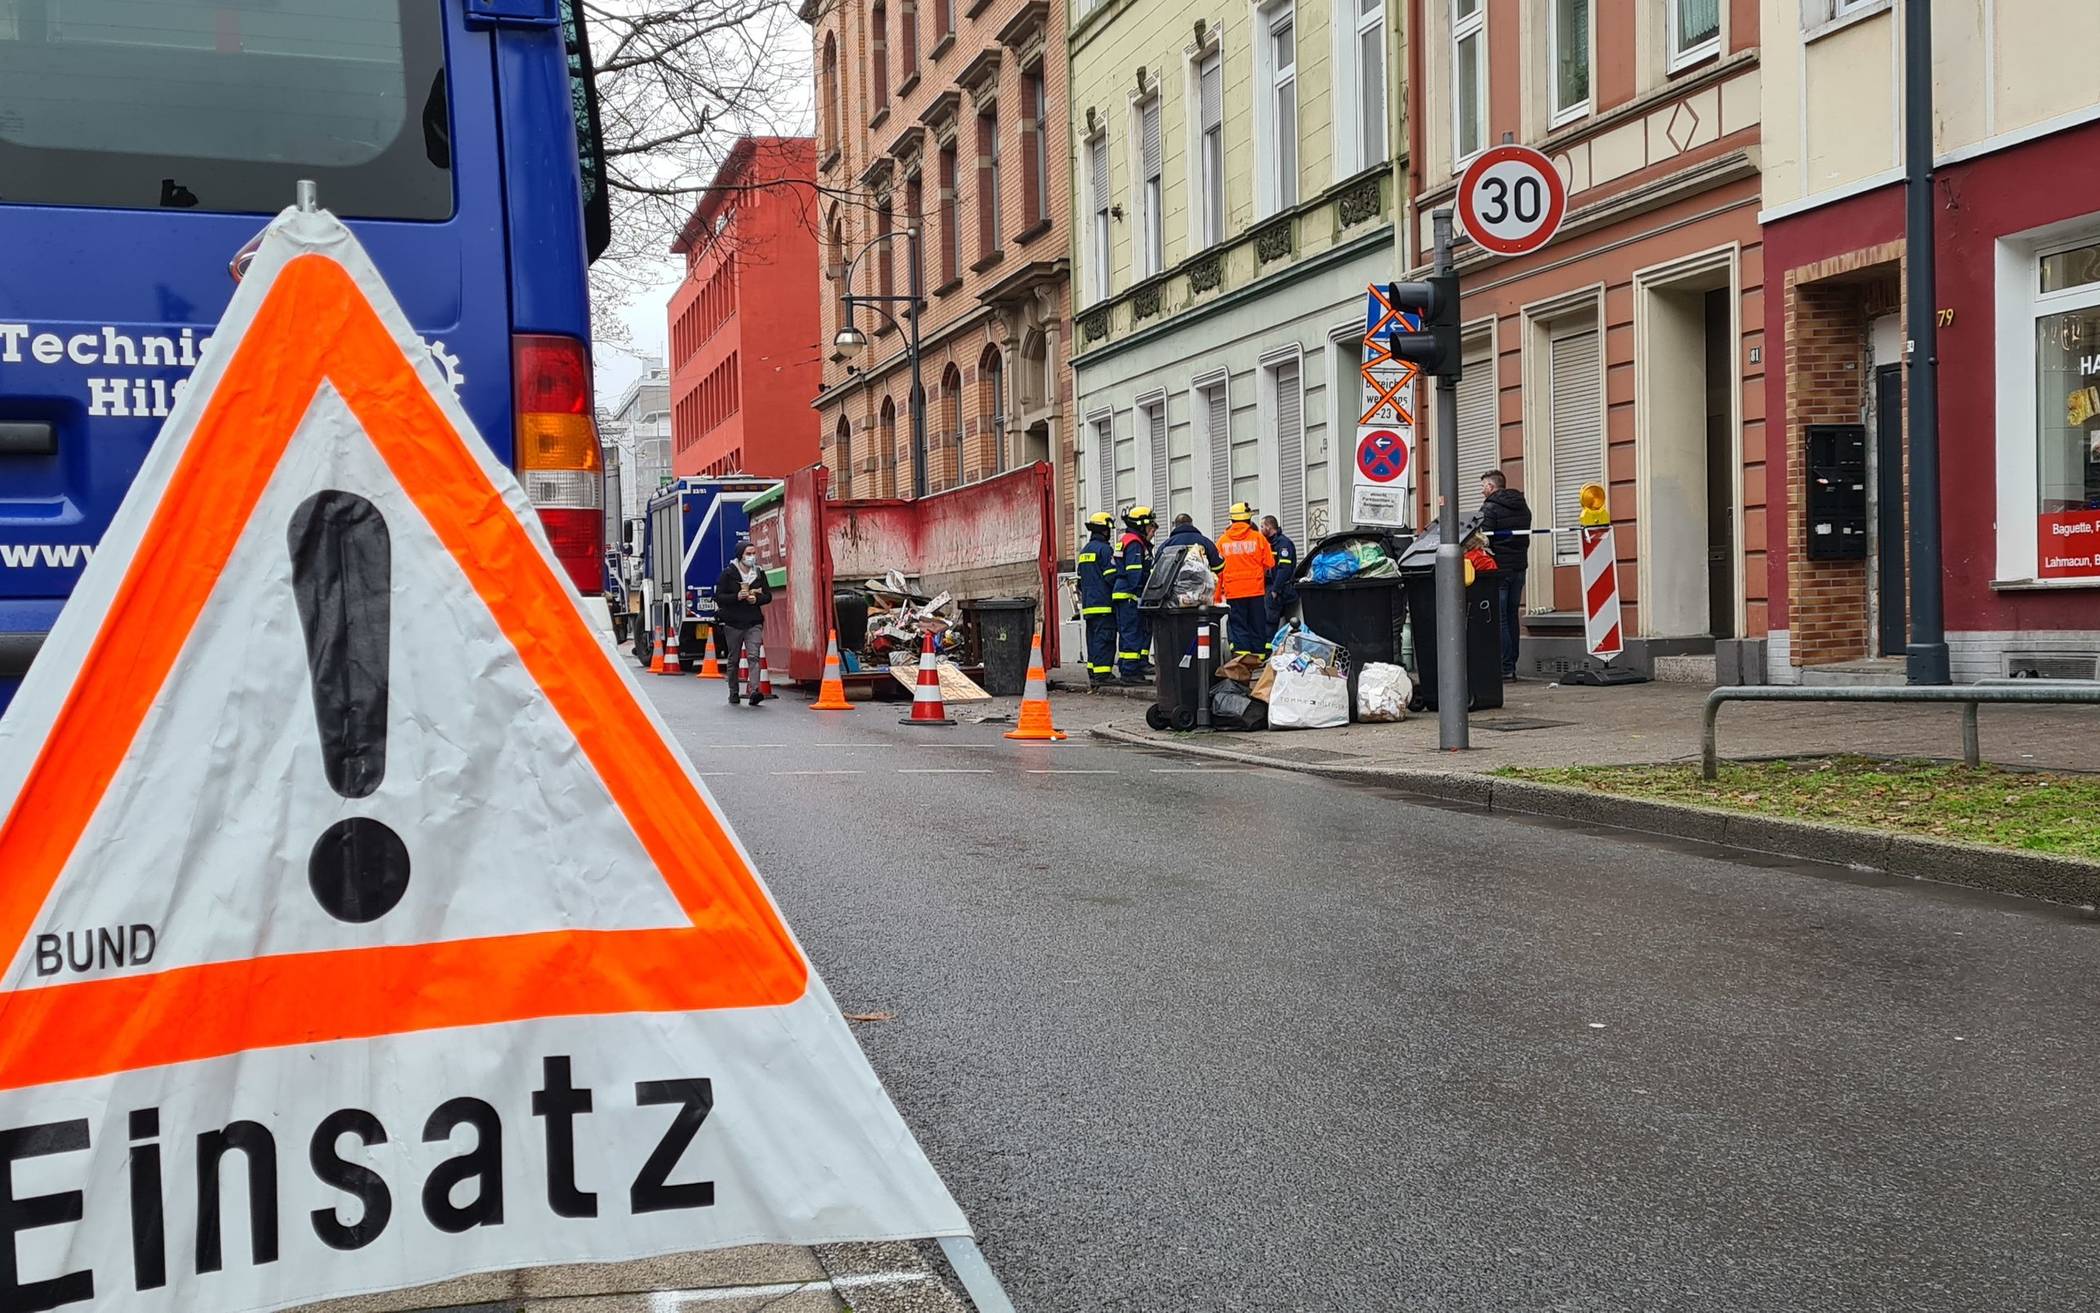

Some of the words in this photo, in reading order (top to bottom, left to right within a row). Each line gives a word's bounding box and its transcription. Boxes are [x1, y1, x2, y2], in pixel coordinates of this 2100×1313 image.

[1481, 175, 1541, 224] 30
[1937, 308, 1954, 327] 79
[1750, 348, 1759, 362] 81
[2052, 522, 2094, 537] Baguette,
[2044, 556, 2093, 569] Lahmacun,
[36, 923, 157, 976] BUND
[0, 1055, 715, 1313] Einsatz
